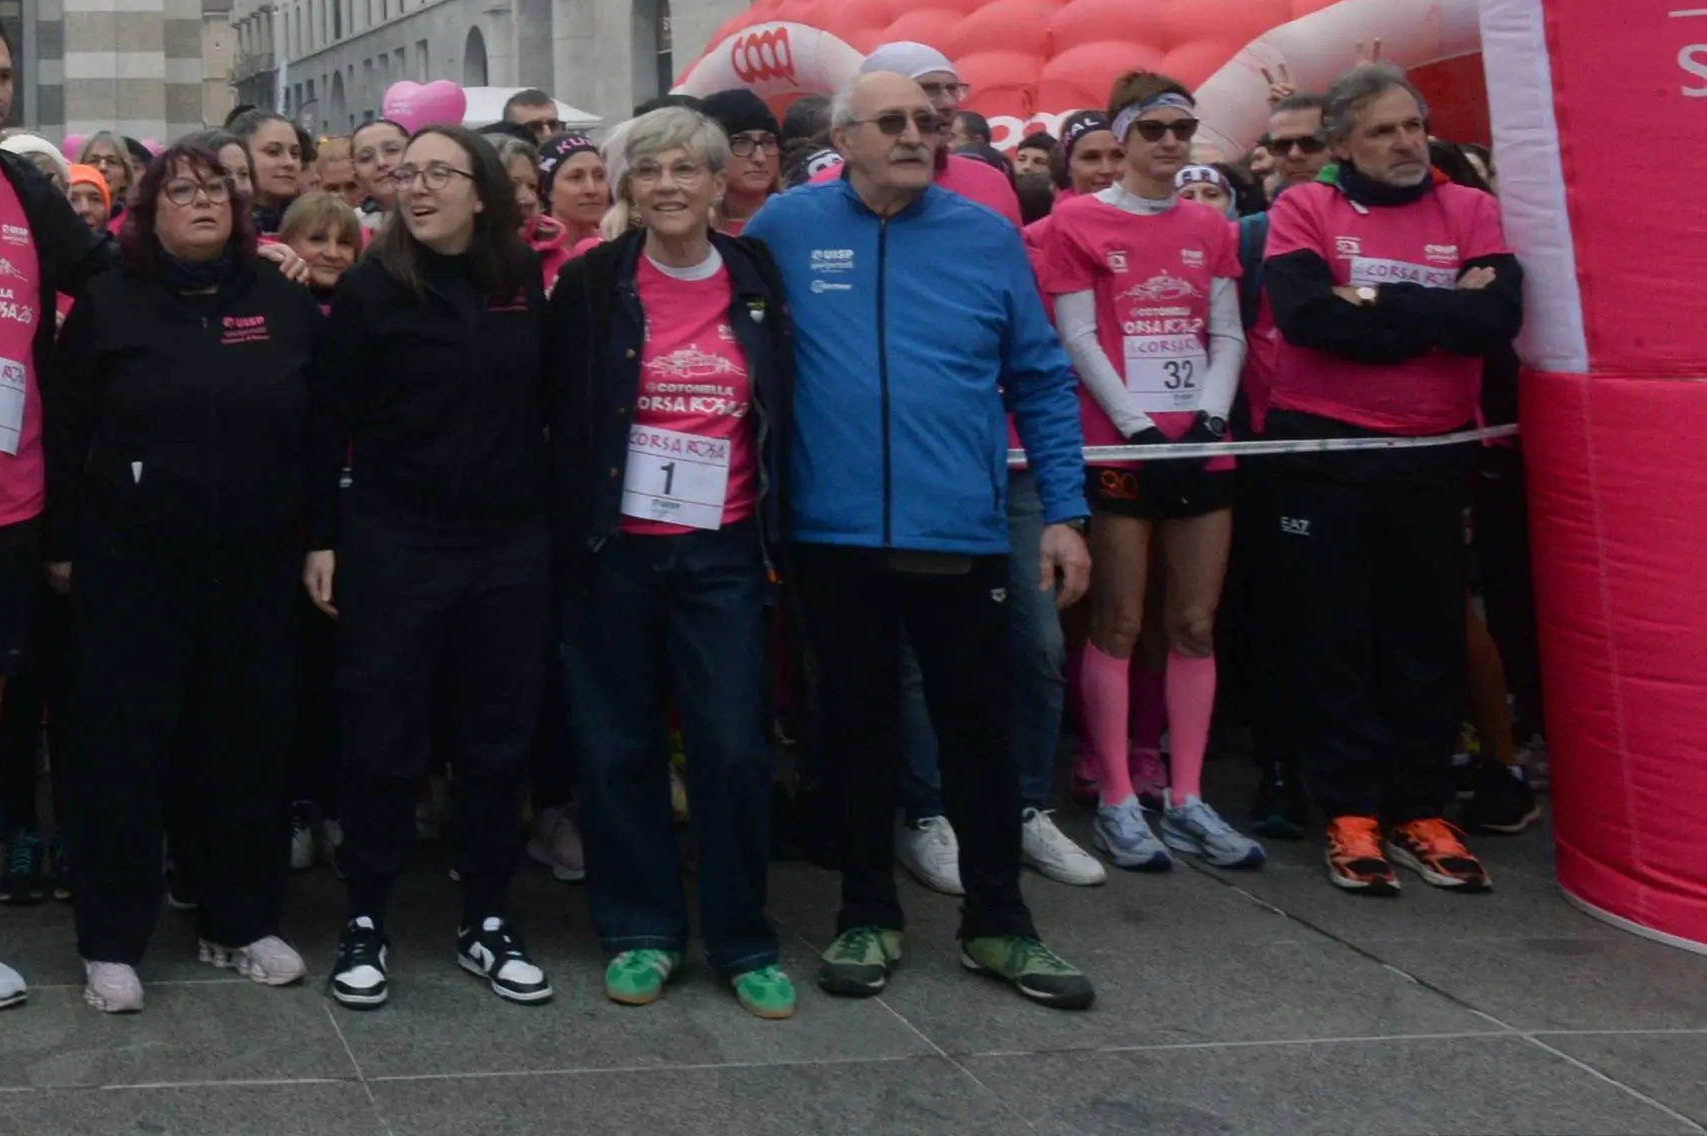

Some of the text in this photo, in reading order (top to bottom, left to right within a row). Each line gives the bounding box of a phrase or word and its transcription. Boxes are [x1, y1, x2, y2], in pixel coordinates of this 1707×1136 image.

[1163, 360, 1195, 389] 32
[657, 382, 735, 396] COTONELLA
[638, 396, 686, 413] ORSA
[660, 462, 675, 495] 1
